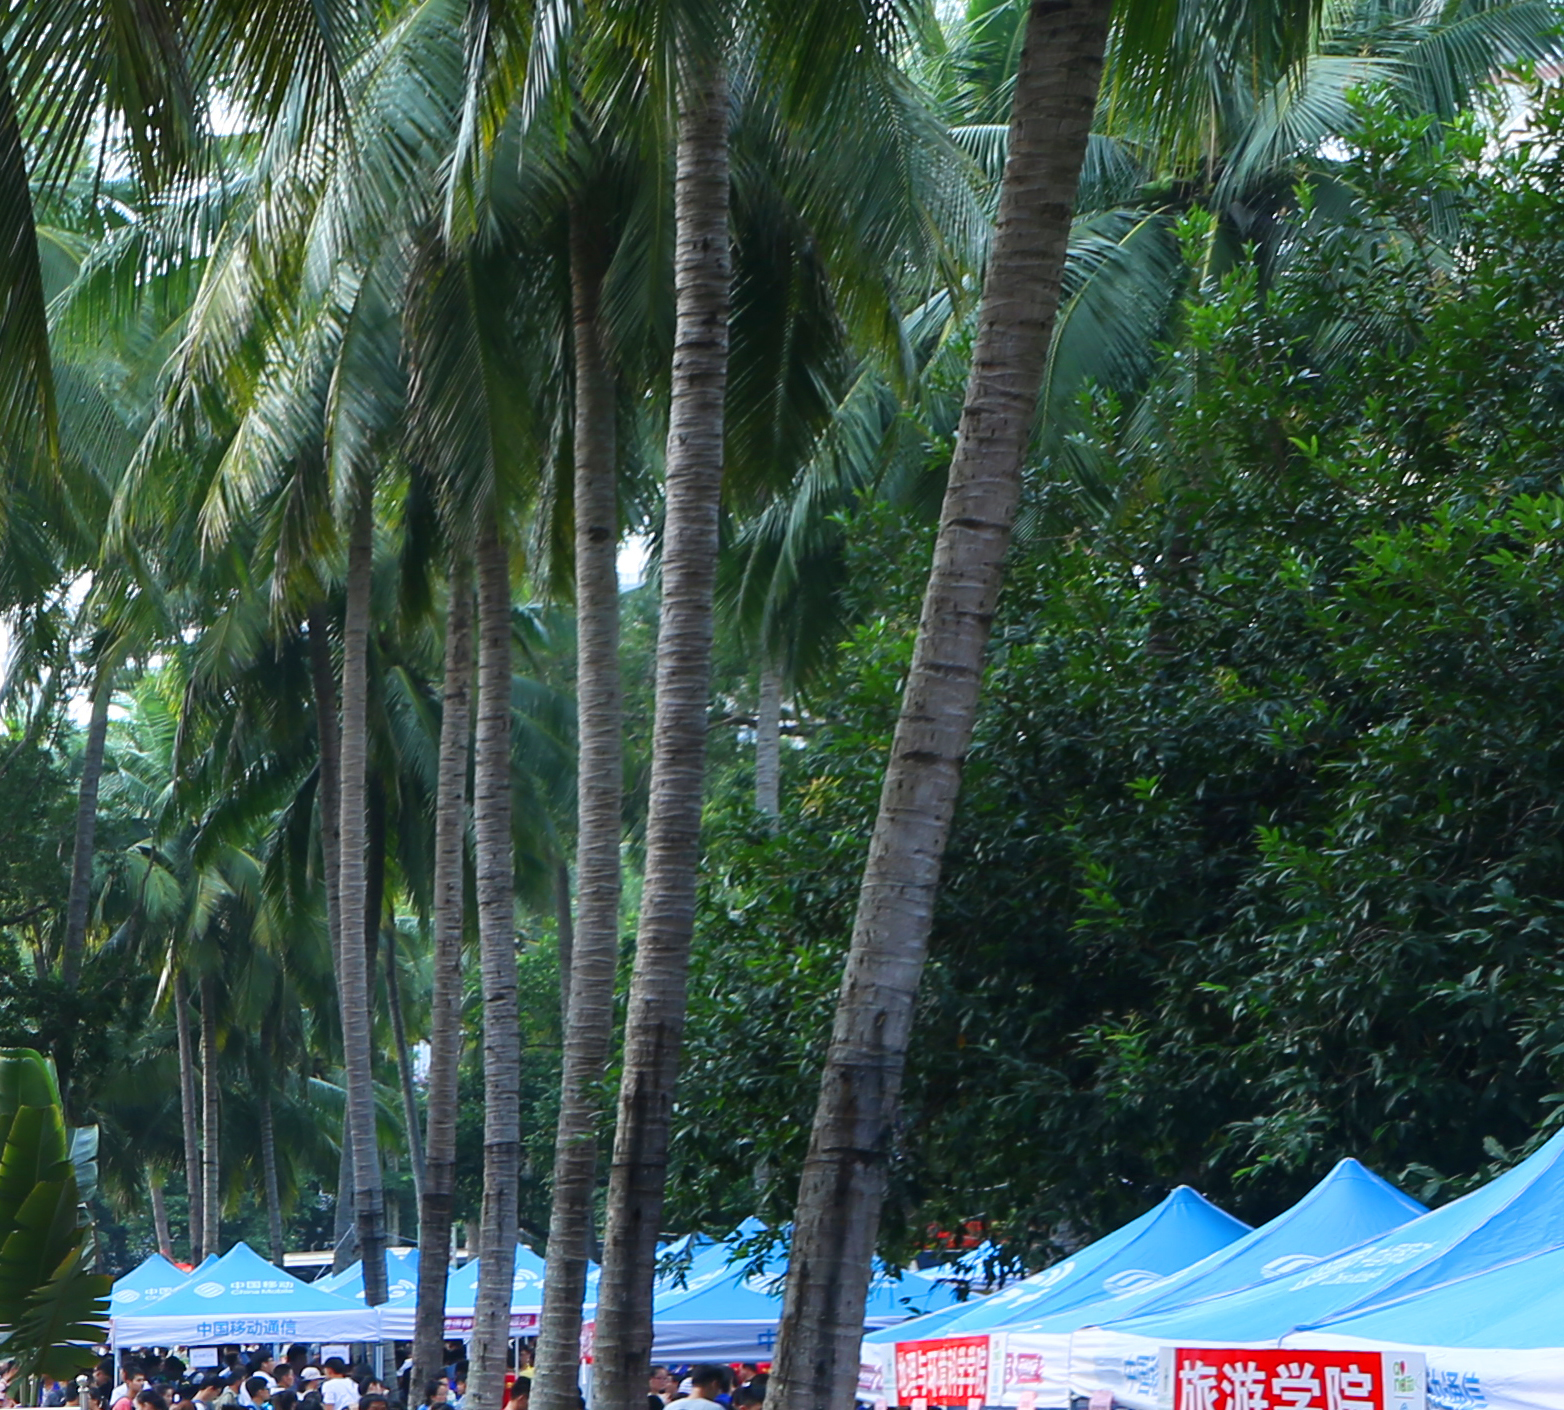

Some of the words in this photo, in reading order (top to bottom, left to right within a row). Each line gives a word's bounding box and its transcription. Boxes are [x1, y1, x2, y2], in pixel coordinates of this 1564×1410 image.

[230, 1279, 295, 1290] 中国移动
[196, 1317, 297, 1337] 中国移动通信
